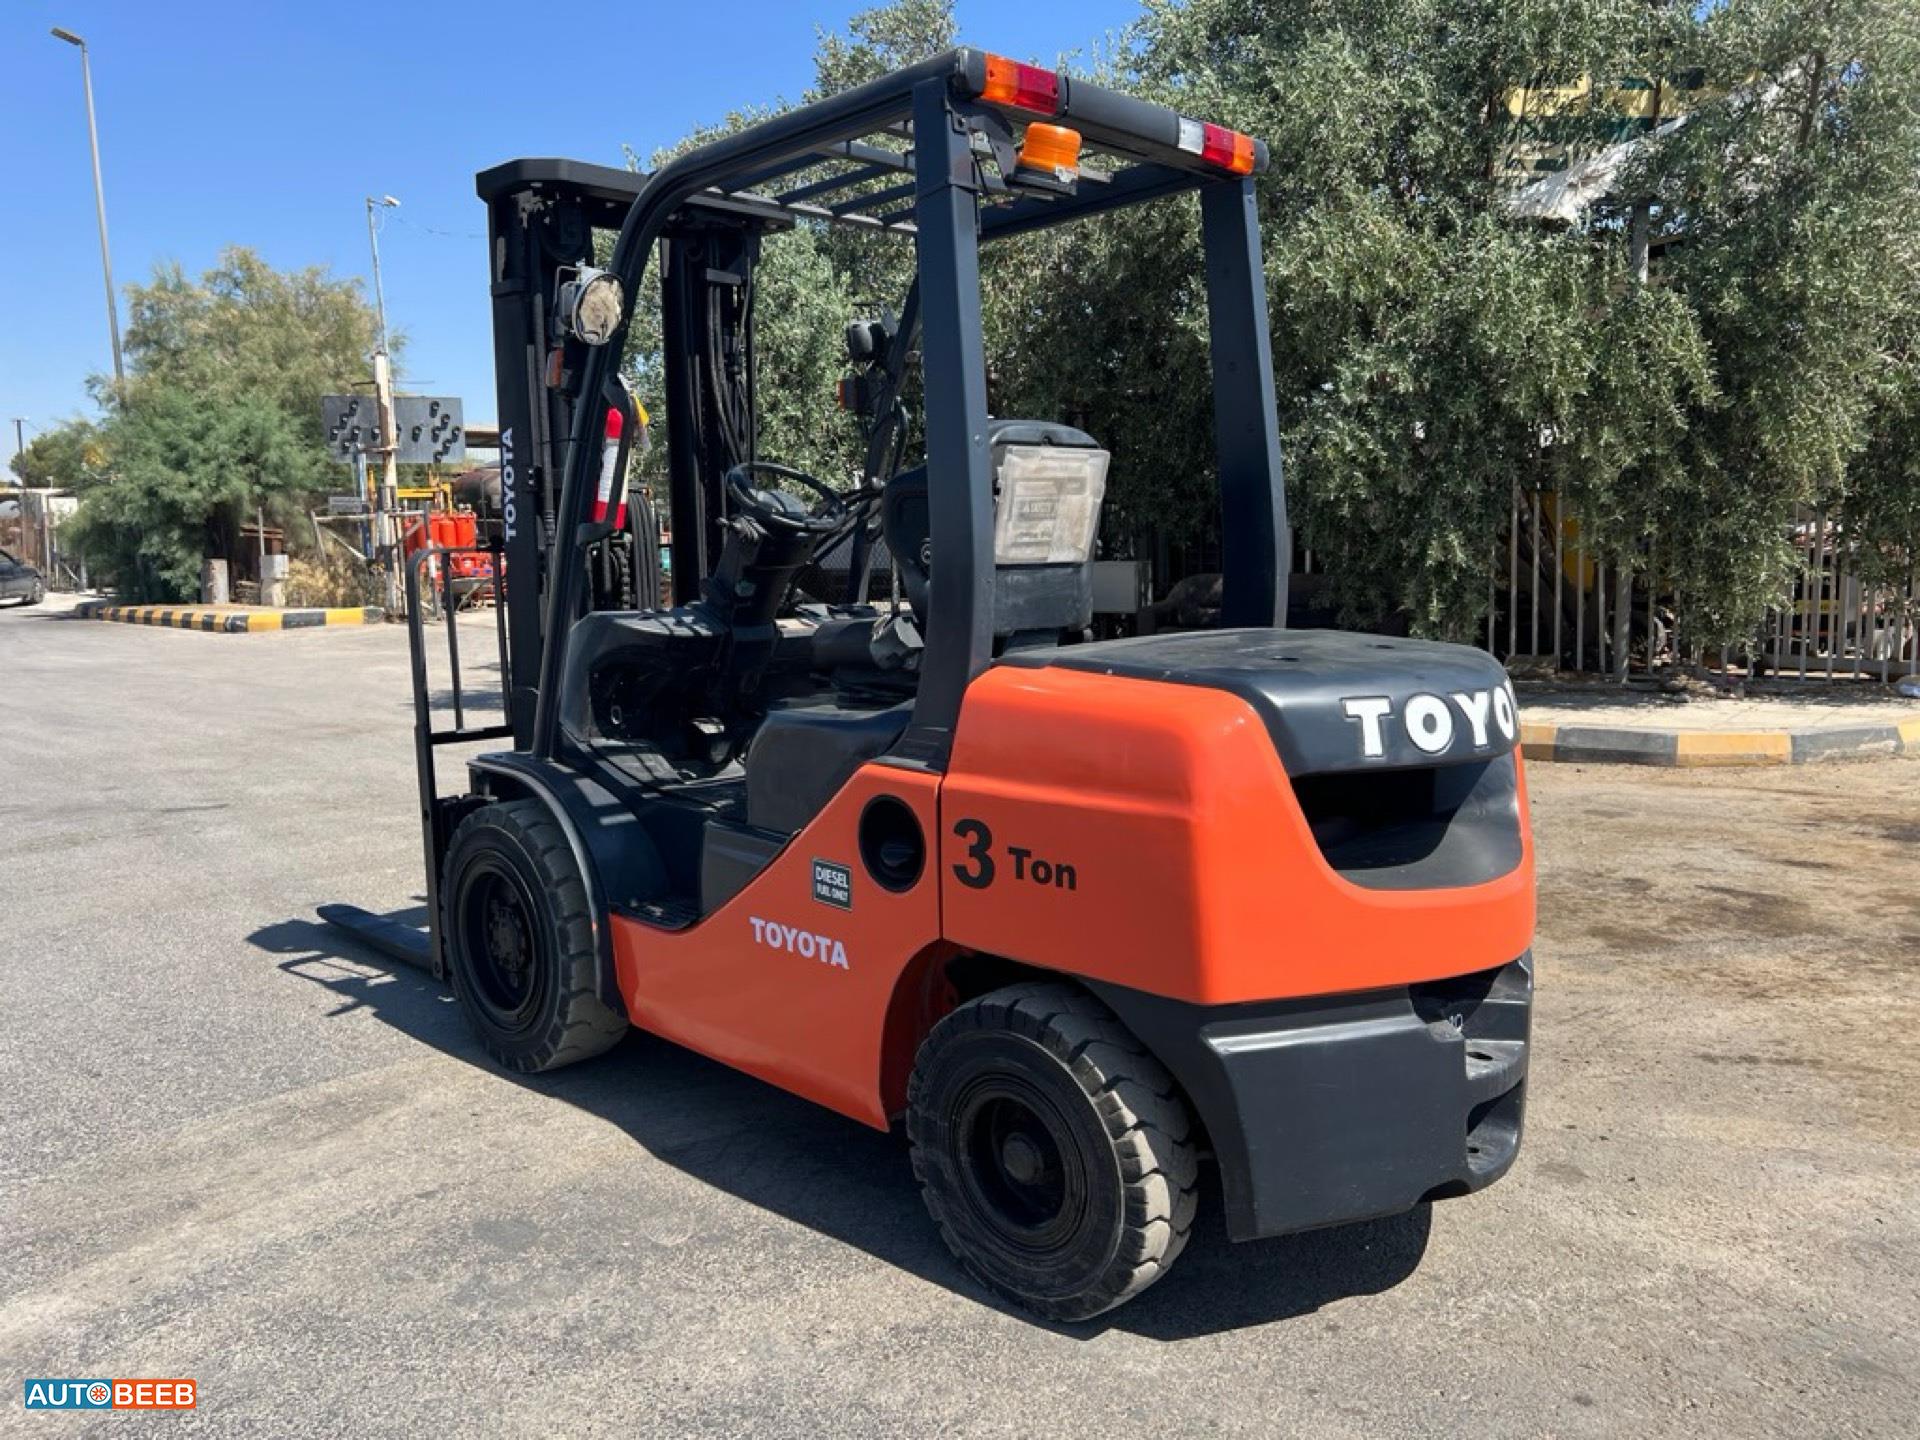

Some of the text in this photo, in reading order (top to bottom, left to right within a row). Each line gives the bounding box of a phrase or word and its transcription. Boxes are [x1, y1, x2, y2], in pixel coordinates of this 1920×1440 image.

[502, 427, 516, 542] TOYOTA
[1344, 682, 1515, 757] TOYO
[815, 865, 849, 888] DIESEL
[953, 818, 1077, 891] 3 Ton
[749, 916, 850, 970] TOYOTA
